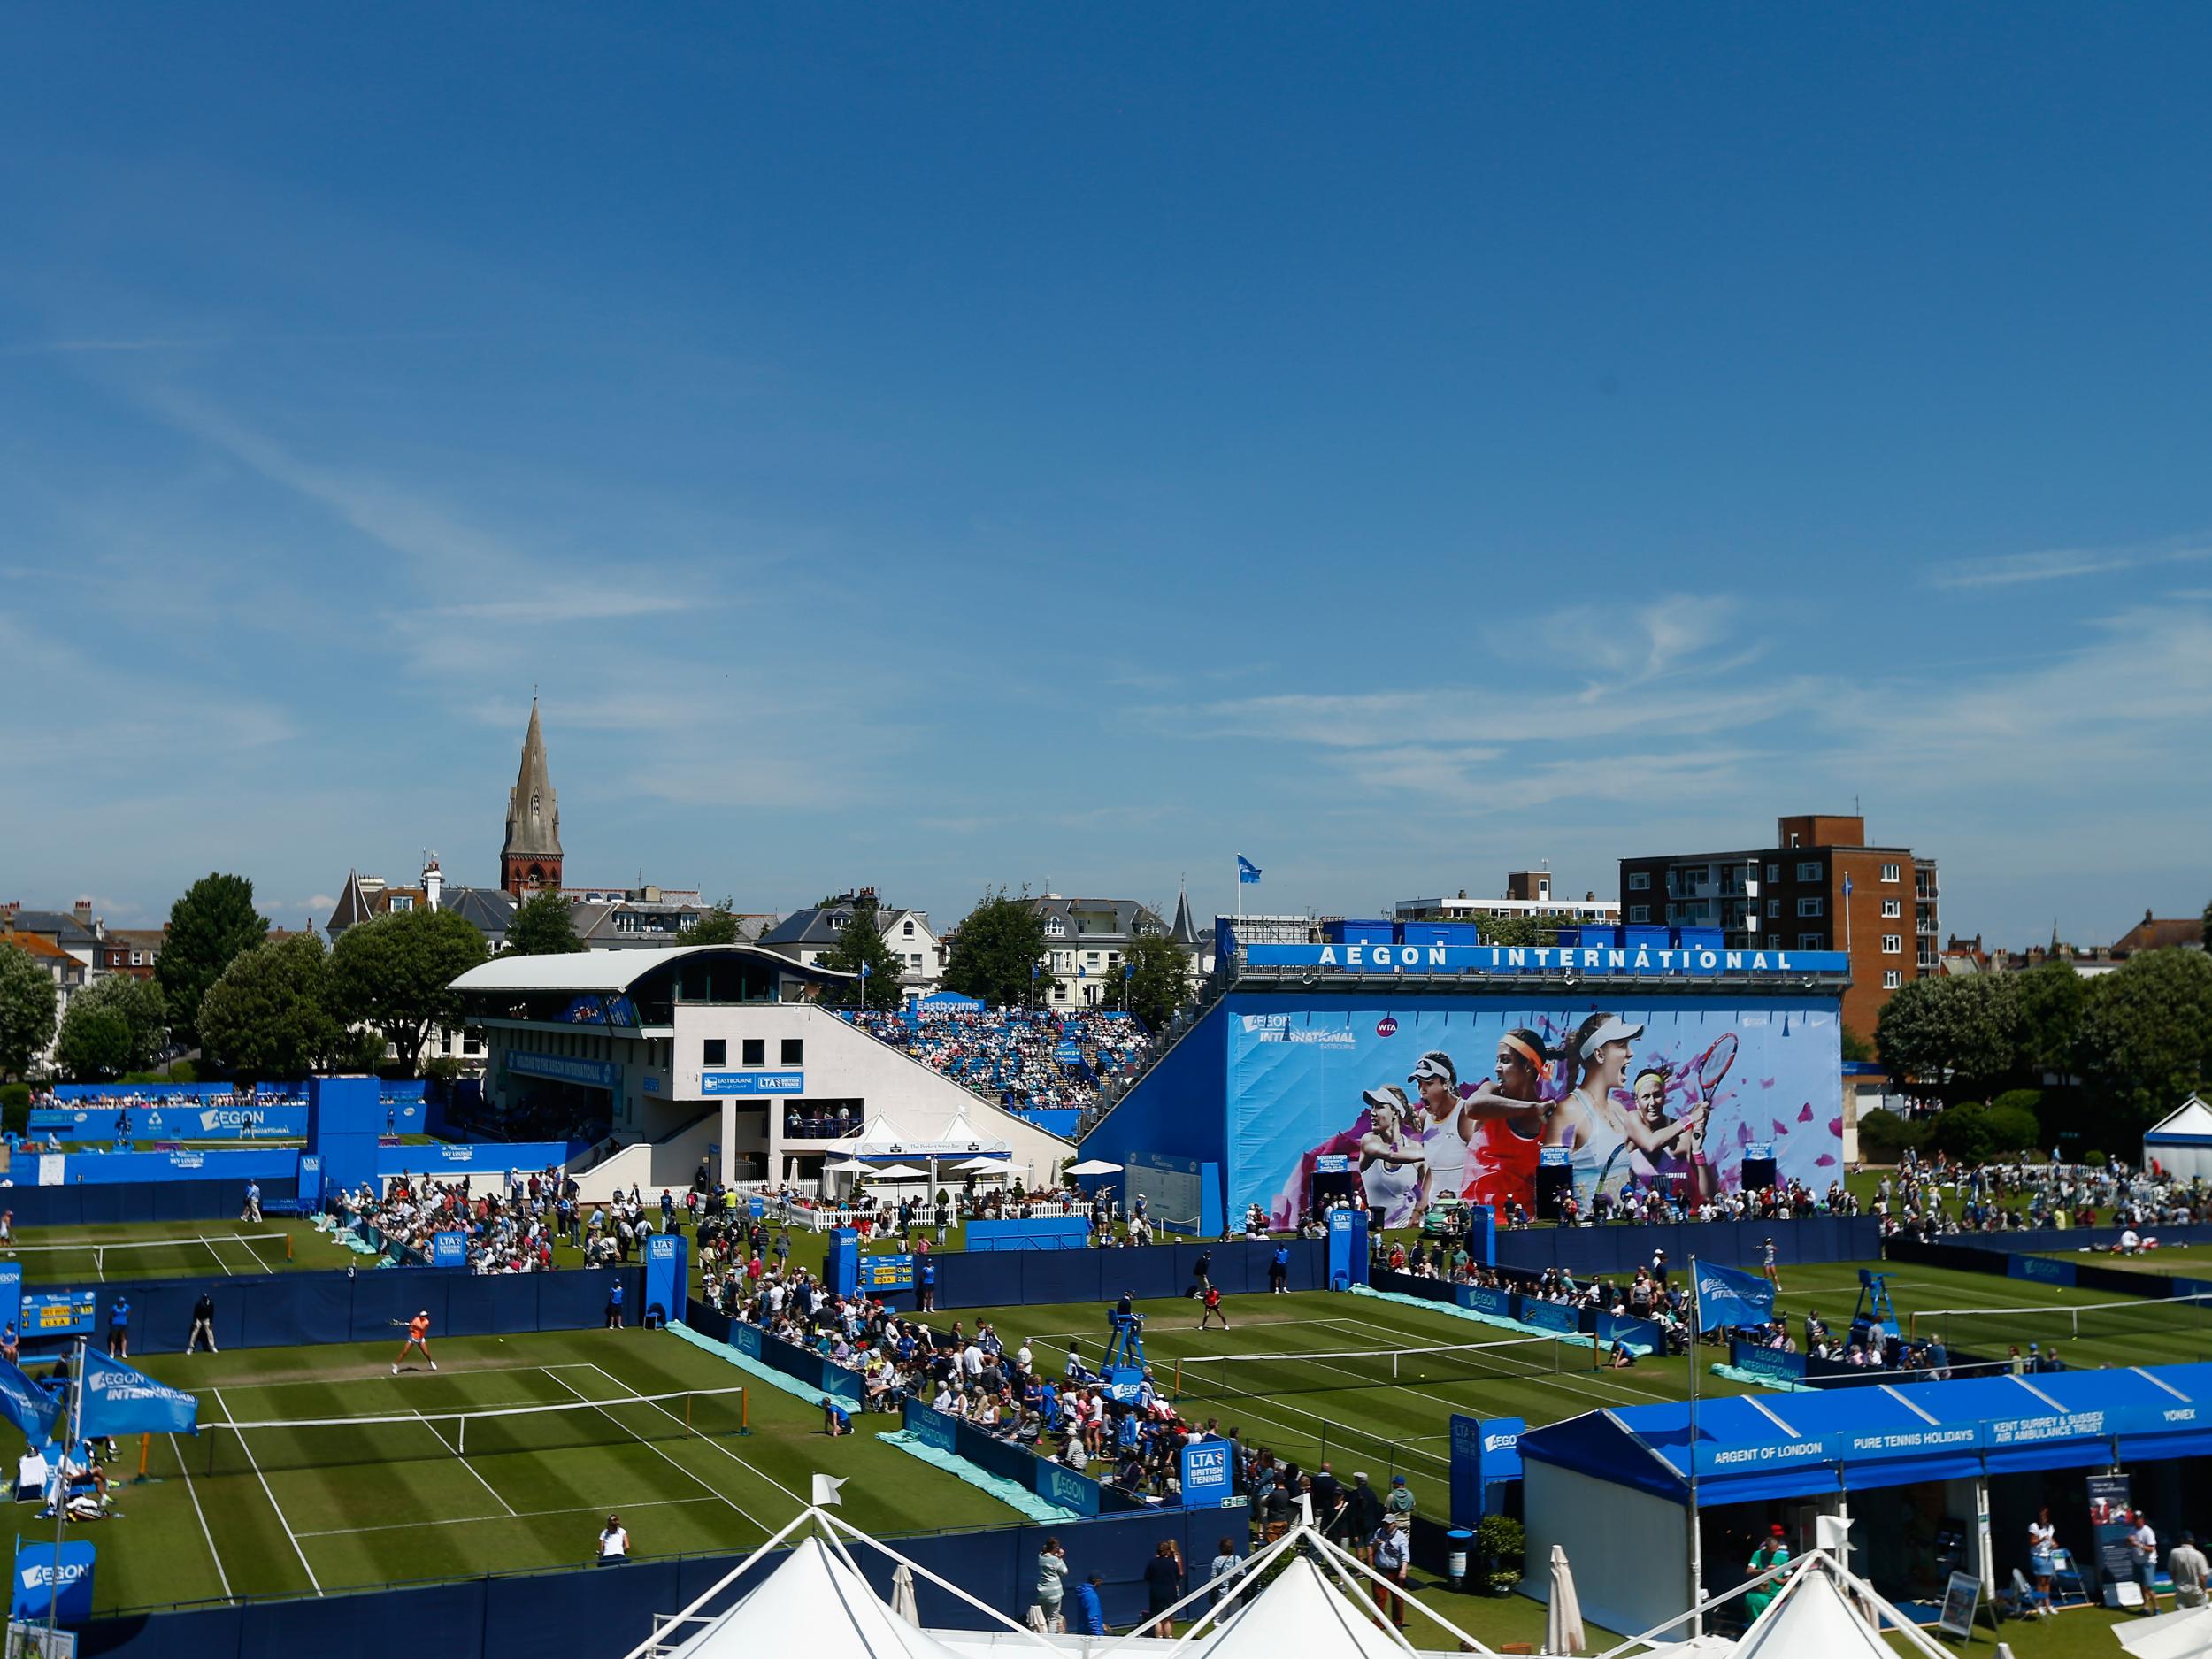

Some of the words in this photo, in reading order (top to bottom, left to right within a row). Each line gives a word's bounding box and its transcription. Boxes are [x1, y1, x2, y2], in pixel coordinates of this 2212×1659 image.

[1318, 946, 1446, 965] AEGON
[1492, 949, 1791, 971] INTERNATIONAL
[916, 1000, 979, 1010] Eastbourne
[1378, 1023, 1396, 1032] WTA
[1260, 1031, 1356, 1043] INTRNATIONAL
[565, 1062, 600, 1081] INTERNATIONAL
[759, 1079, 776, 1087] LTA
[211, 1110, 265, 1125] AEGON
[439, 1237, 455, 1246] LTA
[1100, 1236, 1107, 1245] 4
[348, 1267, 355, 1278] 3
[1472, 1294, 1497, 1308] AEGON
[1755, 1349, 1785, 1363] AEGON
[1740, 1359, 1800, 1379] INTERNATIONAL
[99, 1371, 145, 1386] AEGON
[107, 1385, 196, 1403] INTERNATIONAL
[1118, 1384, 1140, 1395] AEG
[1993, 1421, 2018, 1433] KENT
[2020, 1417, 2058, 1431] SURREY
[2059, 1416, 2066, 1426] &
[2067, 1411, 2105, 1425] SUSSEX
[2162, 1408, 2196, 1422] YONEX
[1455, 1424, 1469, 1438] LTA
[1995, 1431, 2012, 1443] AIR
[2014, 1425, 2071, 1442] AMBULANCE
[2073, 1421, 2103, 1434] TRUST
[1492, 1434, 1517, 1447] AEGO
[1854, 1436, 1883, 1450] PURE
[1884, 1433, 1922, 1448] TENNIS
[1924, 1429, 1974, 1445] HOLIDAYS
[1714, 1448, 1759, 1464] ARGENT
[1761, 1447, 1777, 1459] OF
[1778, 1442, 1823, 1459] LONDON
[1190, 1453, 1216, 1468] LTA
[1190, 1465, 1223, 1477] BRITISH
[1190, 1474, 1223, 1485] TENNIS
[1055, 1481, 1086, 1502] AEGON
[35, 1563, 89, 1582] AEGON
